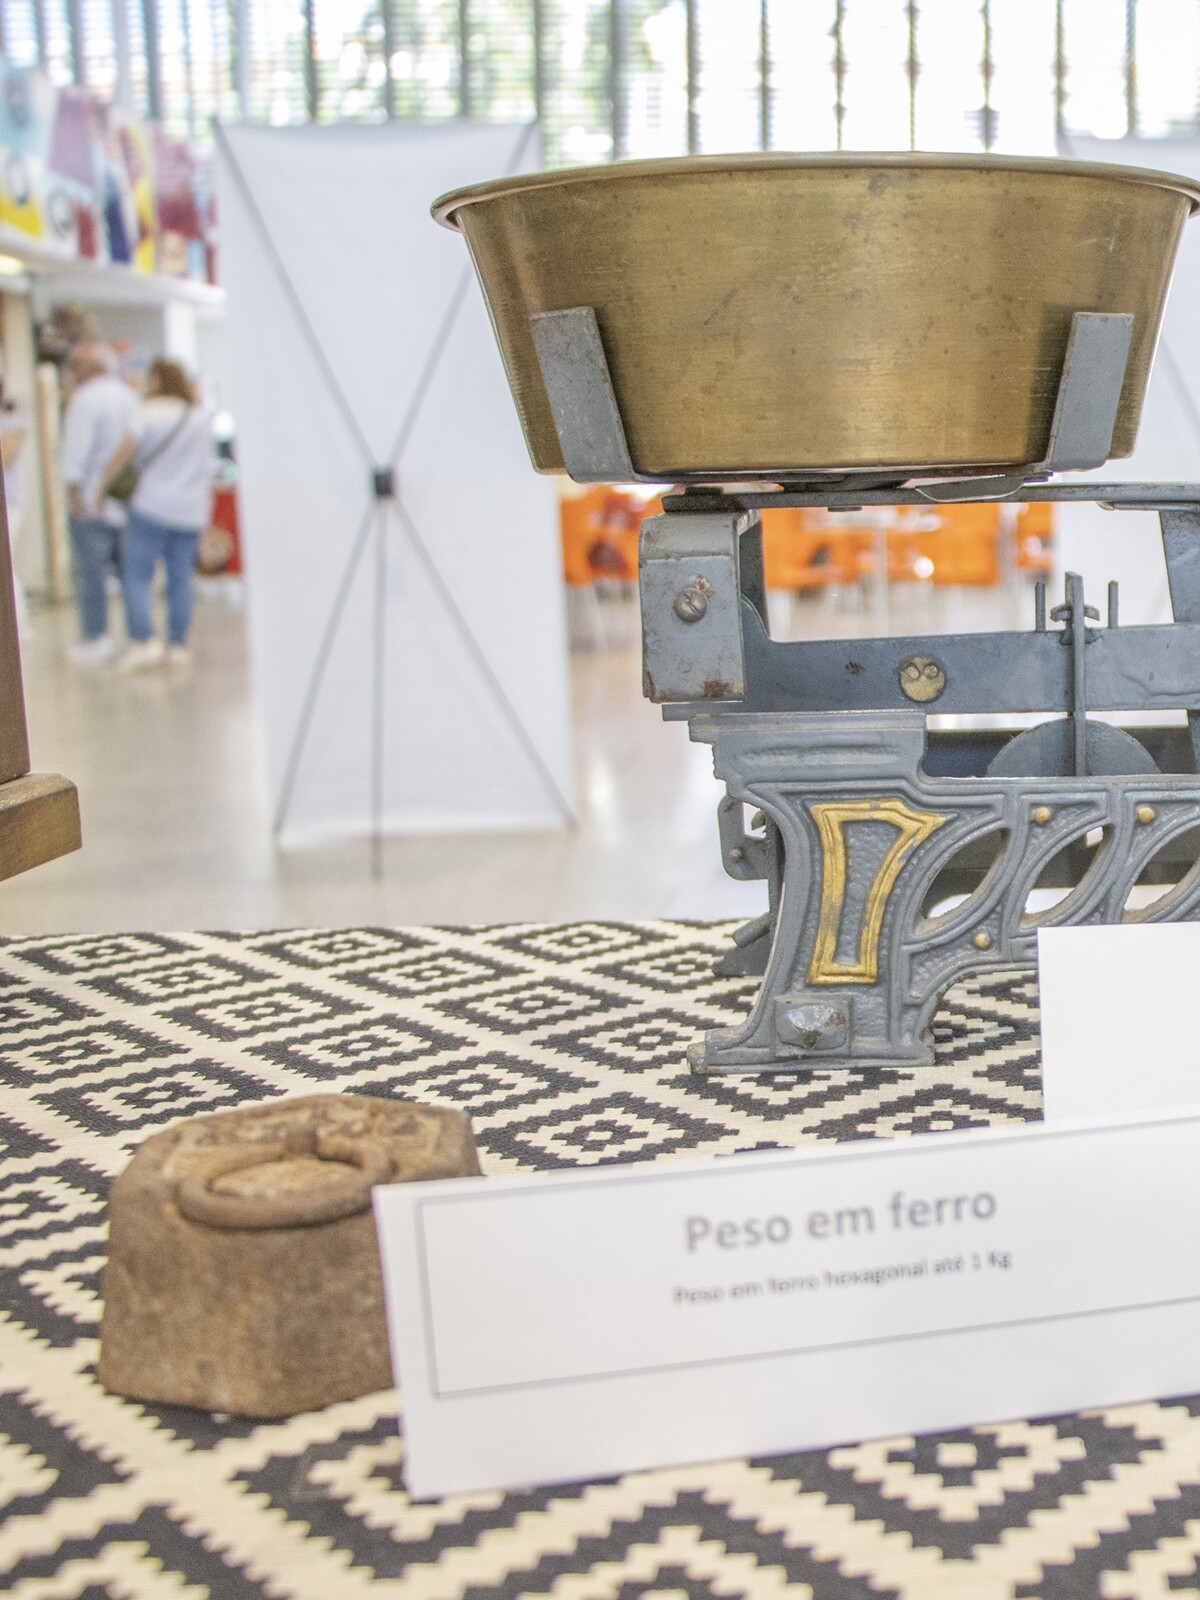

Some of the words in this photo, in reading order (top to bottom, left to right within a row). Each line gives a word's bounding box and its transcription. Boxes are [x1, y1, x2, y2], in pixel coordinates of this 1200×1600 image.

[684, 1214, 793, 1254] Peso
[805, 1205, 876, 1241] em
[889, 1189, 998, 1231] ferro
[673, 1285, 725, 1305] Peso
[728, 1281, 764, 1299] em
[767, 1274, 820, 1294] ferro
[822, 1259, 929, 1287] hexagonal
[932, 1254, 966, 1275] até
[971, 1252, 982, 1271] 1
[986, 1250, 1013, 1271] Kg
